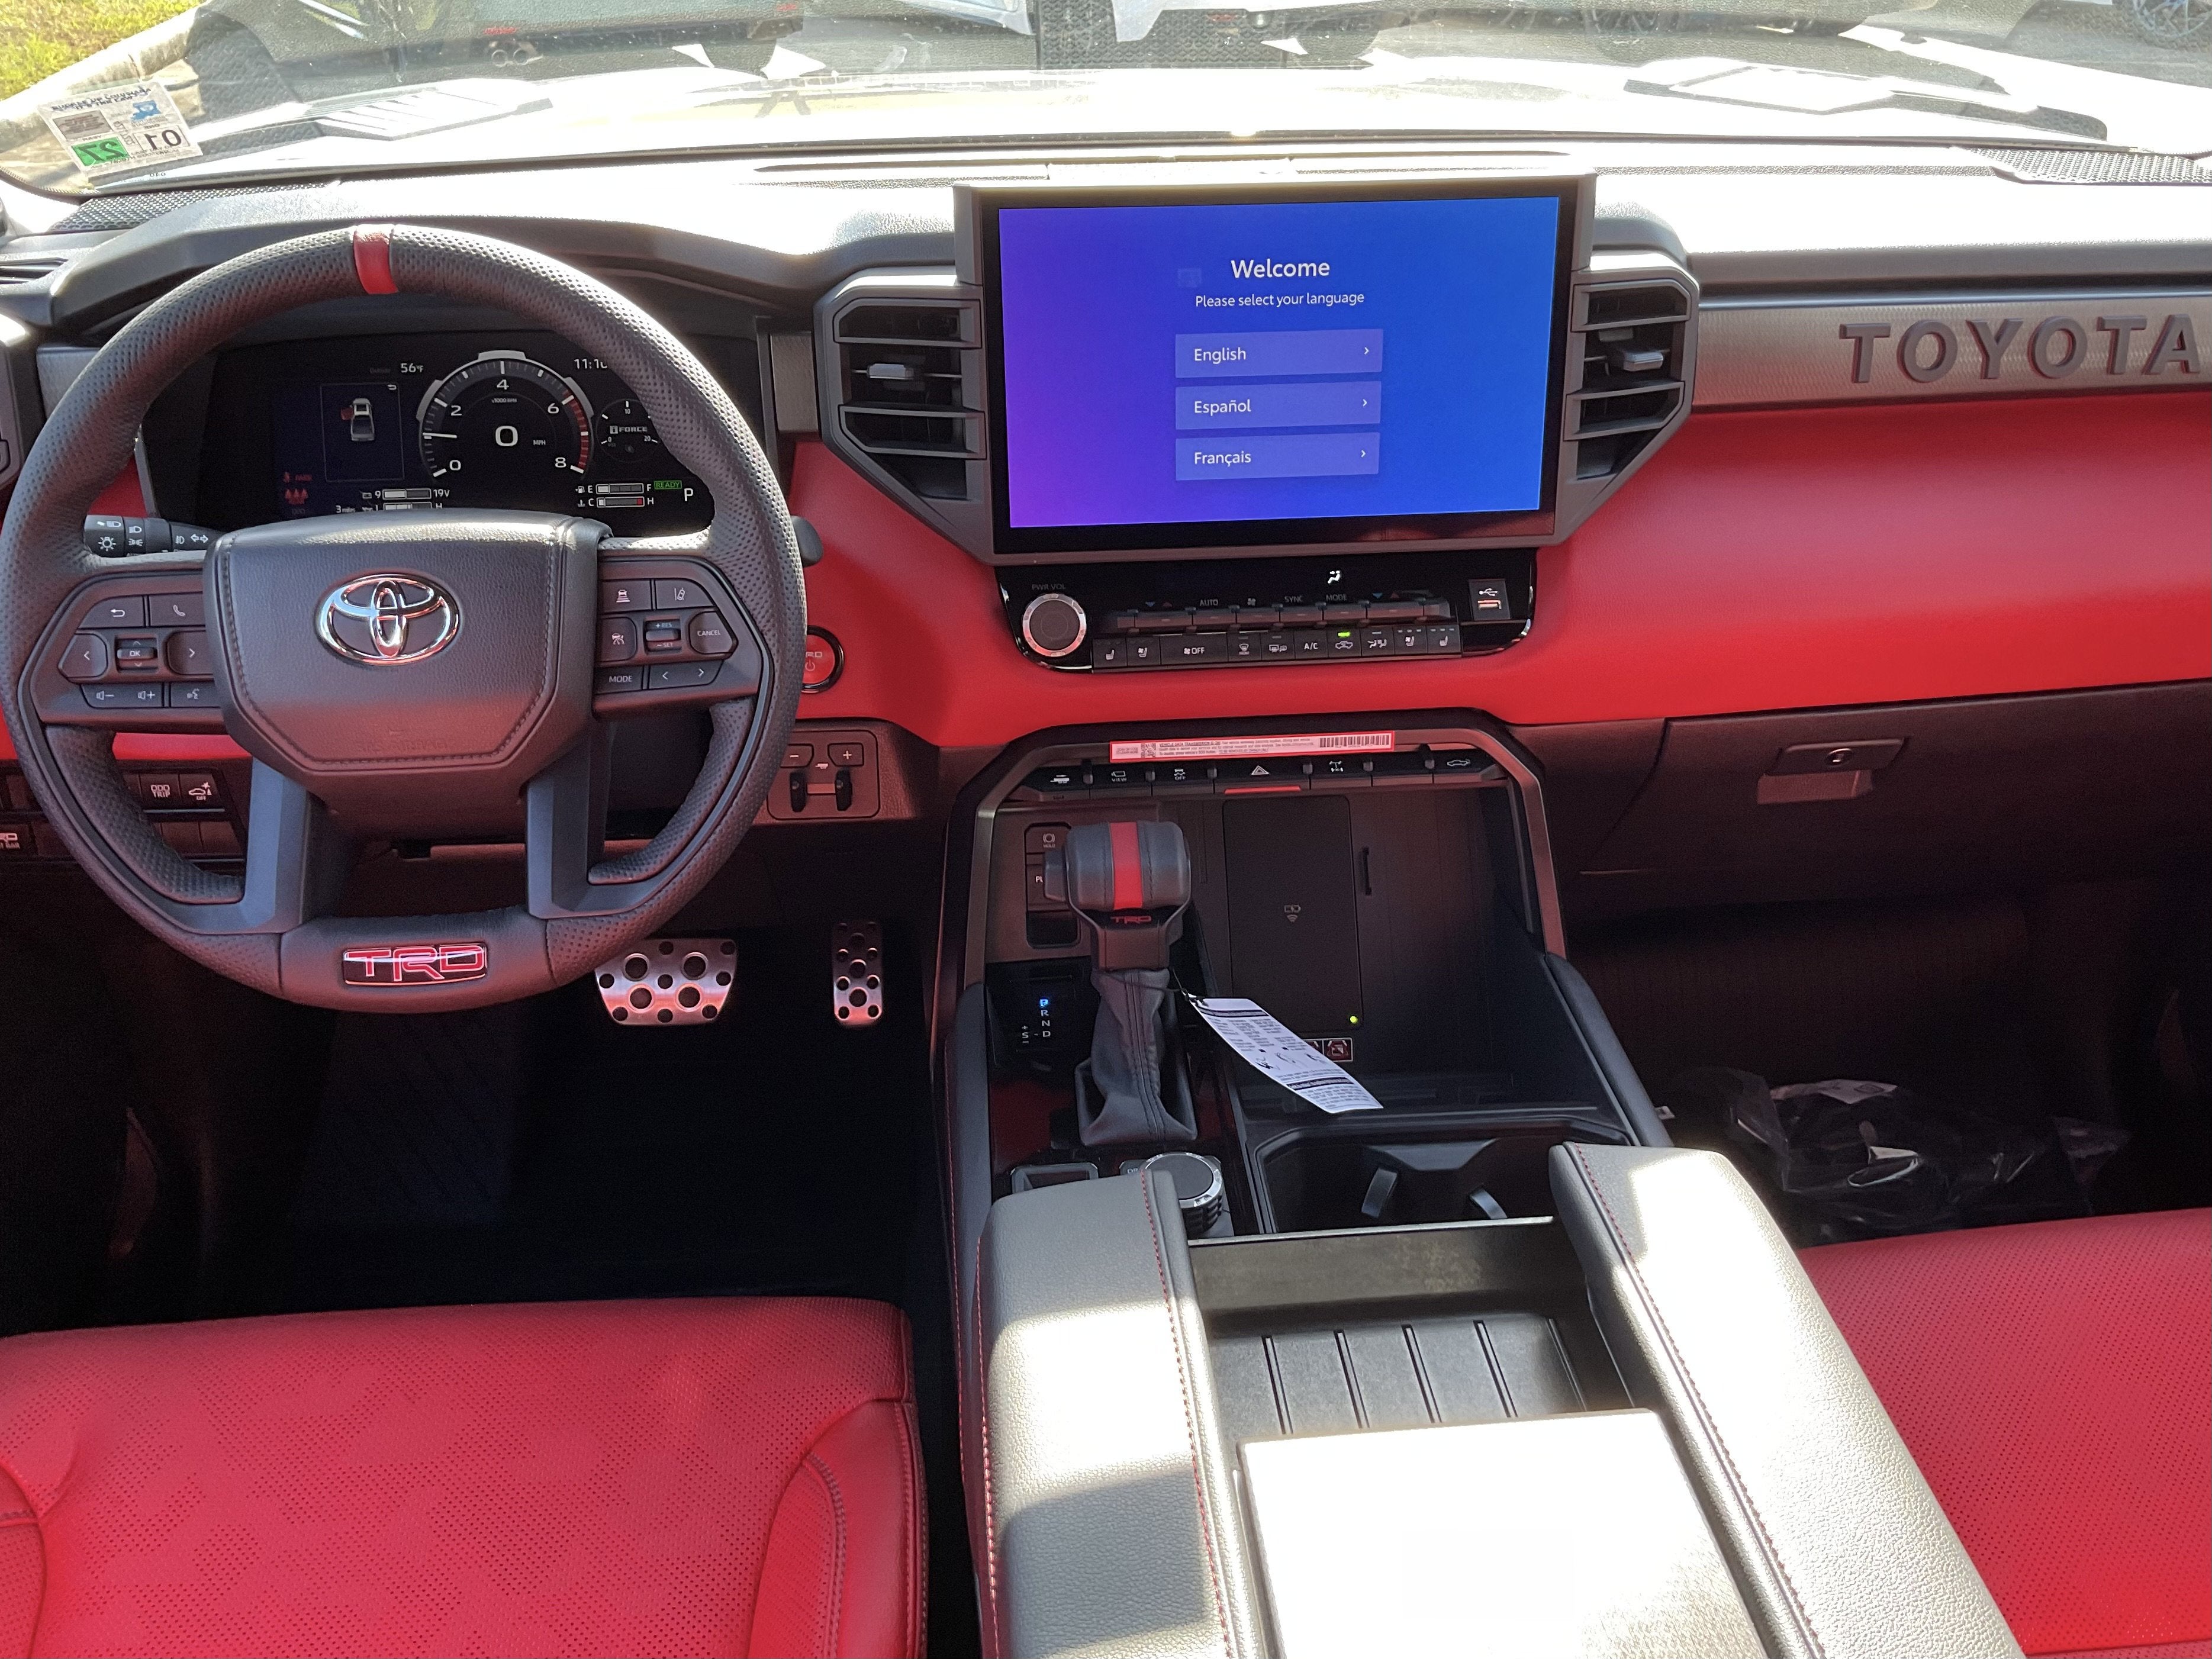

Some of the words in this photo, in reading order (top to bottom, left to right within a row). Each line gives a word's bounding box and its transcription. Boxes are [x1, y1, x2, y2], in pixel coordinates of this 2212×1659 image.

[1231, 258, 1330, 278] Welcome
[1196, 295, 1235, 307] Please
[1238, 294, 1274, 306] select
[1276, 296, 1305, 307] your
[1307, 292, 1364, 306] language
[1839, 314, 2200, 384] TOYOTA
[1194, 347, 1247, 365] English
[497, 379, 509, 390] 4
[450, 405, 462, 415] 2
[548, 403, 559, 413] 6
[1194, 400, 1251, 415] Español
[495, 426, 519, 447] 0
[555, 457, 566, 468] 8
[1194, 451, 1251, 466] Français
[449, 459, 462, 470] 0
[655, 481, 681, 489] READY
[433, 489, 450, 497] 19V
[684, 488, 694, 501] P
[336, 505, 342, 513] 3
[1191, 646, 1205, 655] OFF
[343, 945, 484, 981] TRD
[1039, 998, 1049, 1007] P
